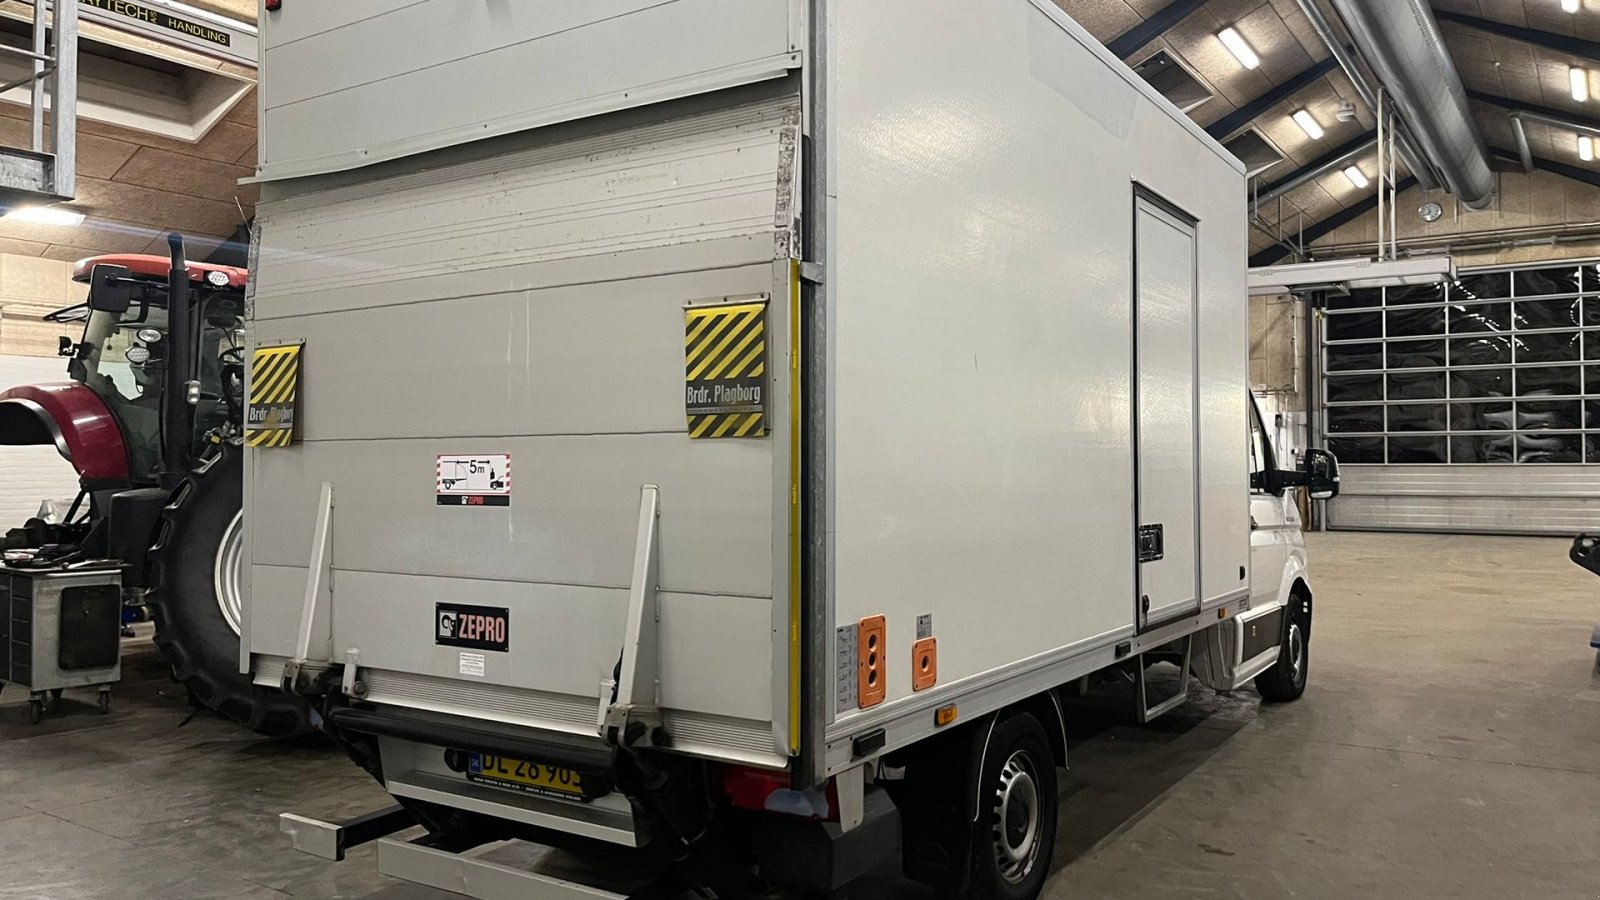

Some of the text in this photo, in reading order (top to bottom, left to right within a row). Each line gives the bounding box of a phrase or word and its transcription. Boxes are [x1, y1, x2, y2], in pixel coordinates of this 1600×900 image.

[78, 0, 148, 21] YTECH
[168, 18, 226, 43] HANDLING
[687, 383, 761, 405] Brdr. Plagborg
[459, 614, 505, 643] ZEPRO
